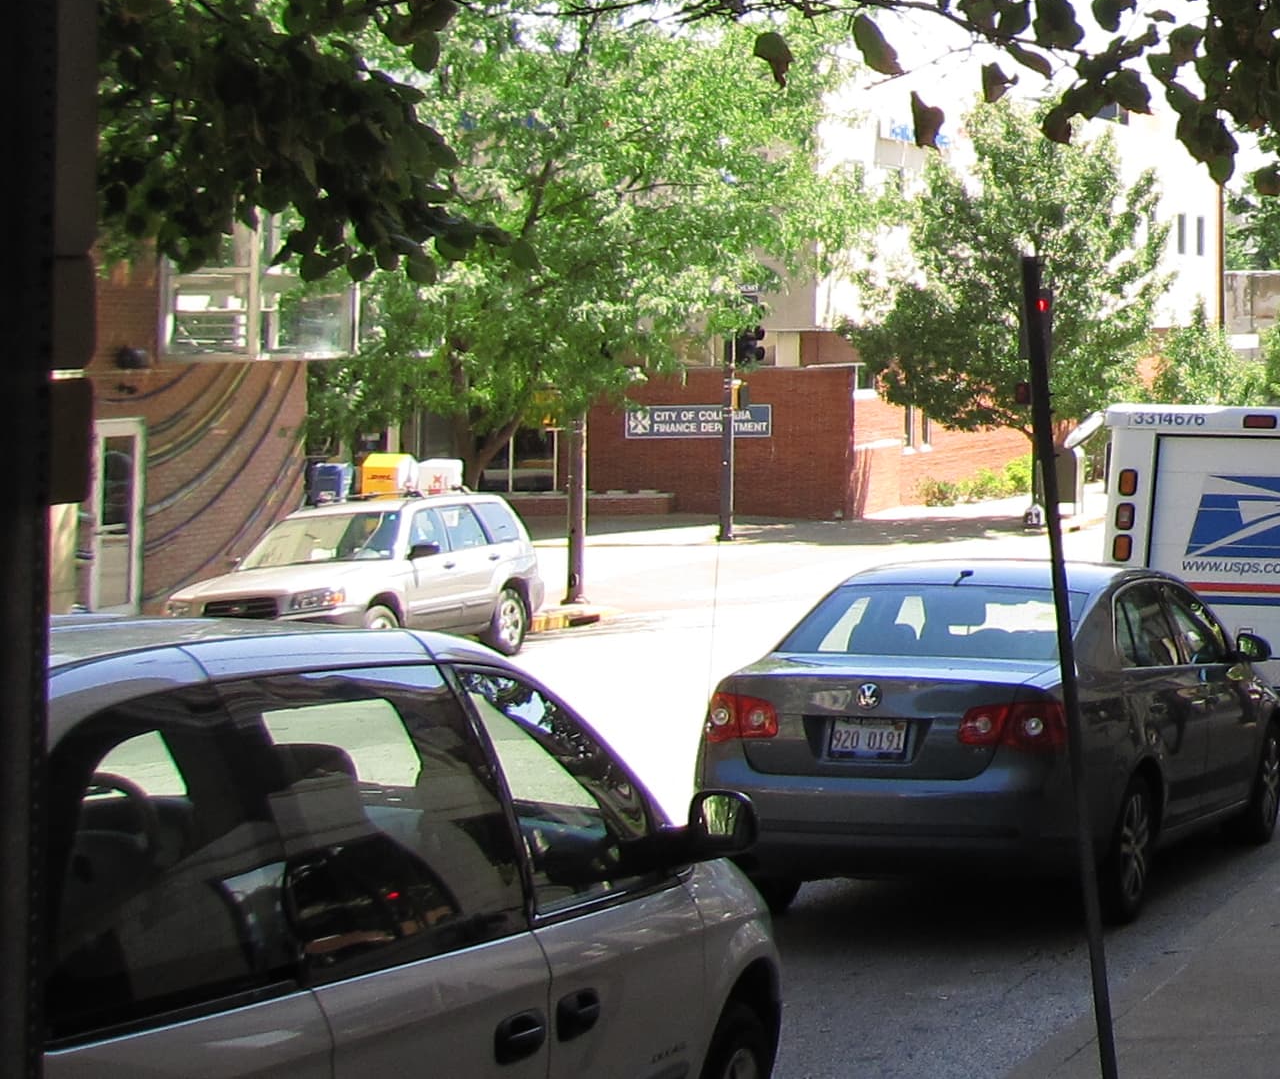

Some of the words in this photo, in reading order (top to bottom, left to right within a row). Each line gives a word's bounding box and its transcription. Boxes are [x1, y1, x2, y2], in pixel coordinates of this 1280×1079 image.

[654, 410, 677, 421] CITY
[680, 410, 696, 421] OF
[1134, 412, 1206, 426] 3314676
[653, 422, 697, 432] FINANCE
[833, 729, 860, 750] 920
